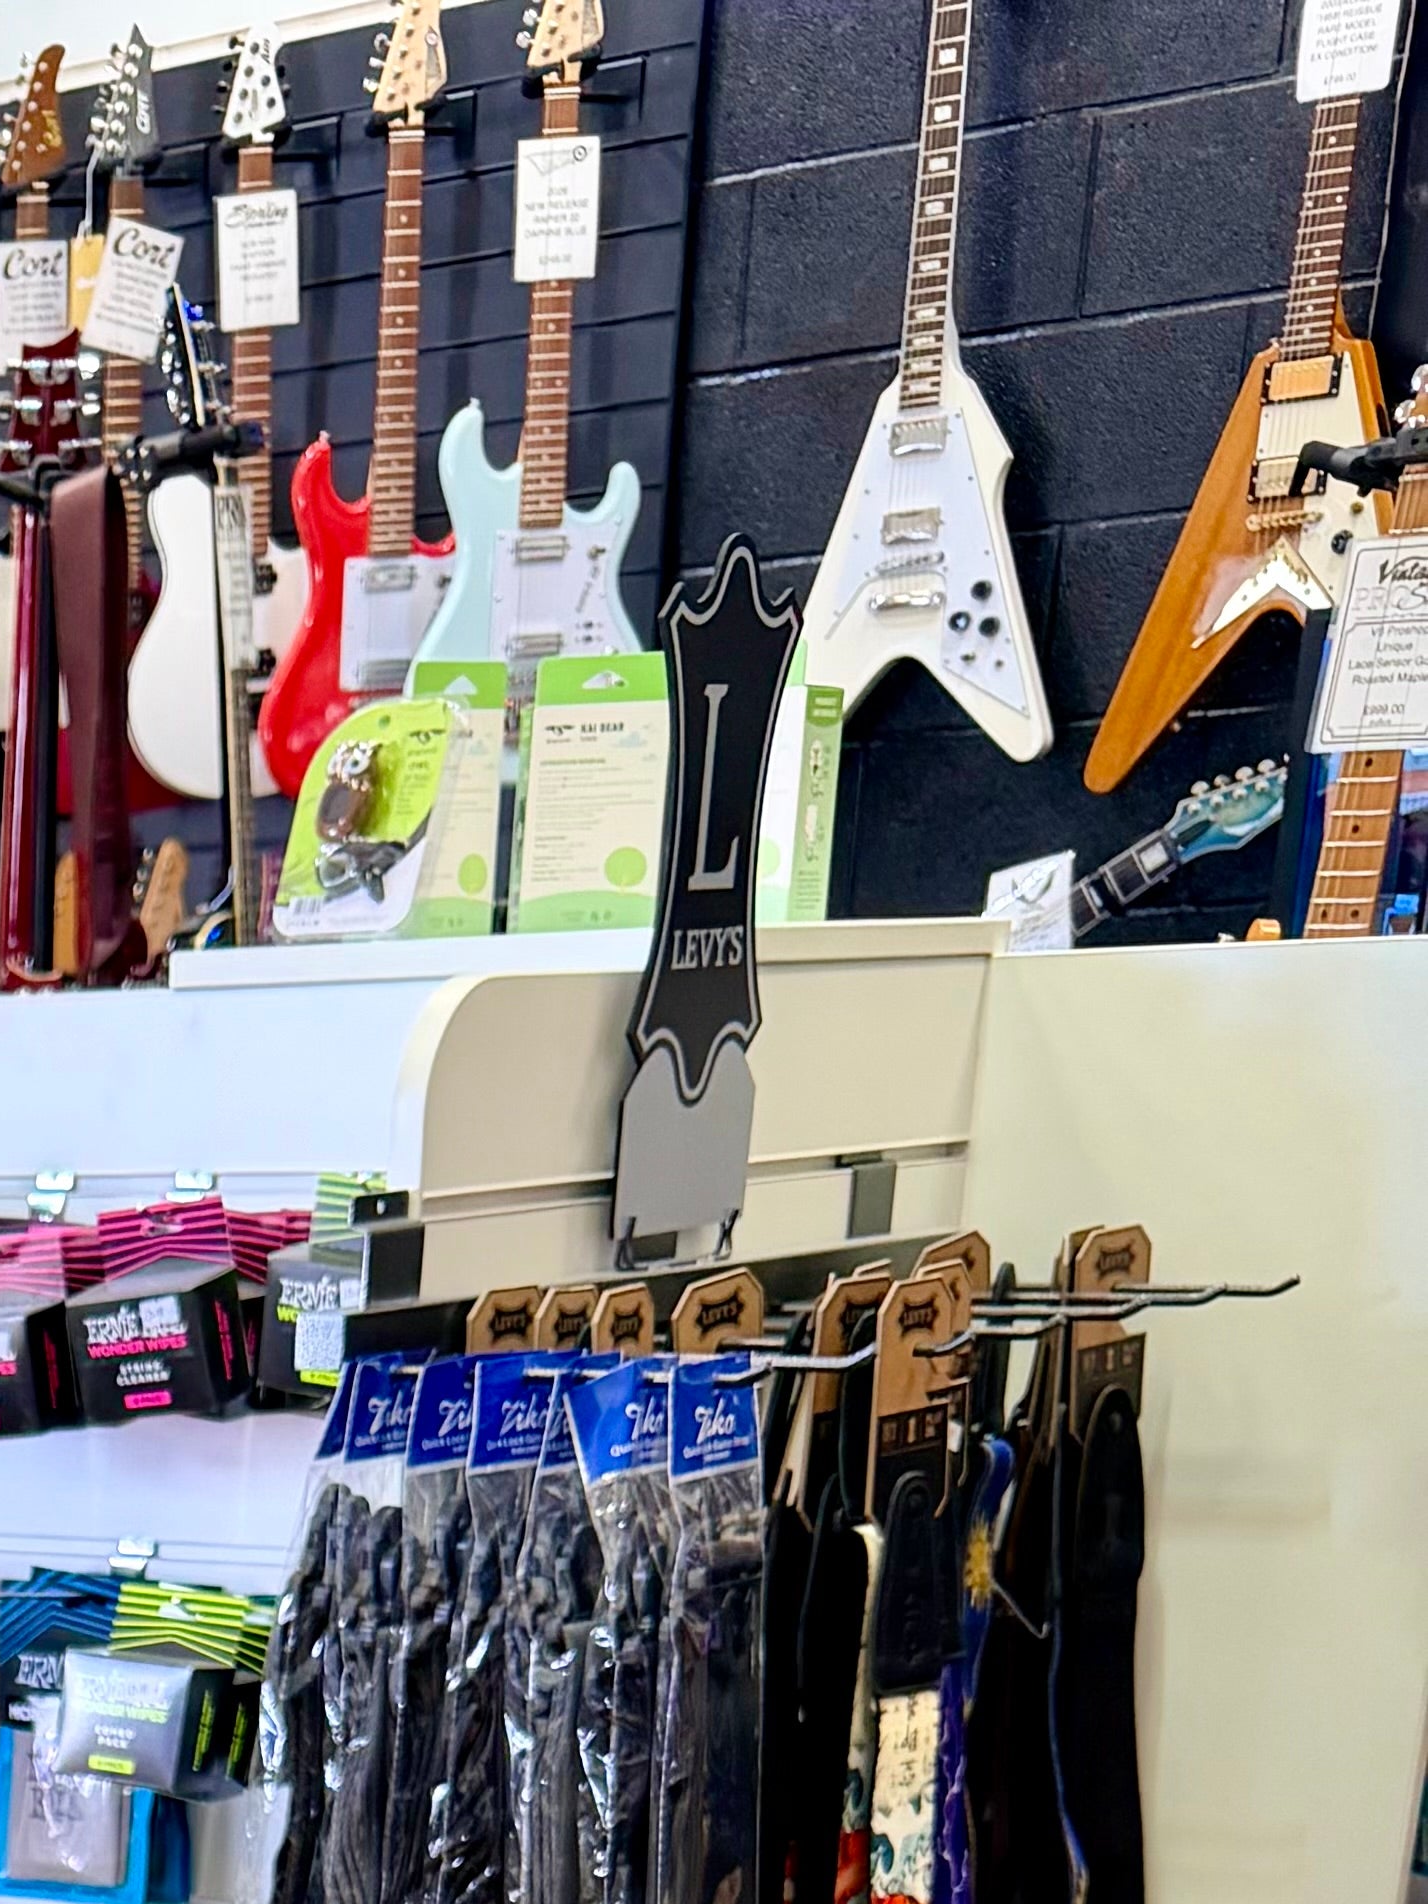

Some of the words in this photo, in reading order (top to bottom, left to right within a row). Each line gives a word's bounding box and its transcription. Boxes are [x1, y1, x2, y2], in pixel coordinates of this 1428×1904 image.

[1379, 556, 1428, 584] Vinta
[688, 683, 740, 891] L
[670, 926, 744, 972] LEVY'S
[280, 1274, 339, 1311] ERNIE
[84, 1304, 140, 1345] ERNIE
[15, 1653, 65, 1690] ERN
